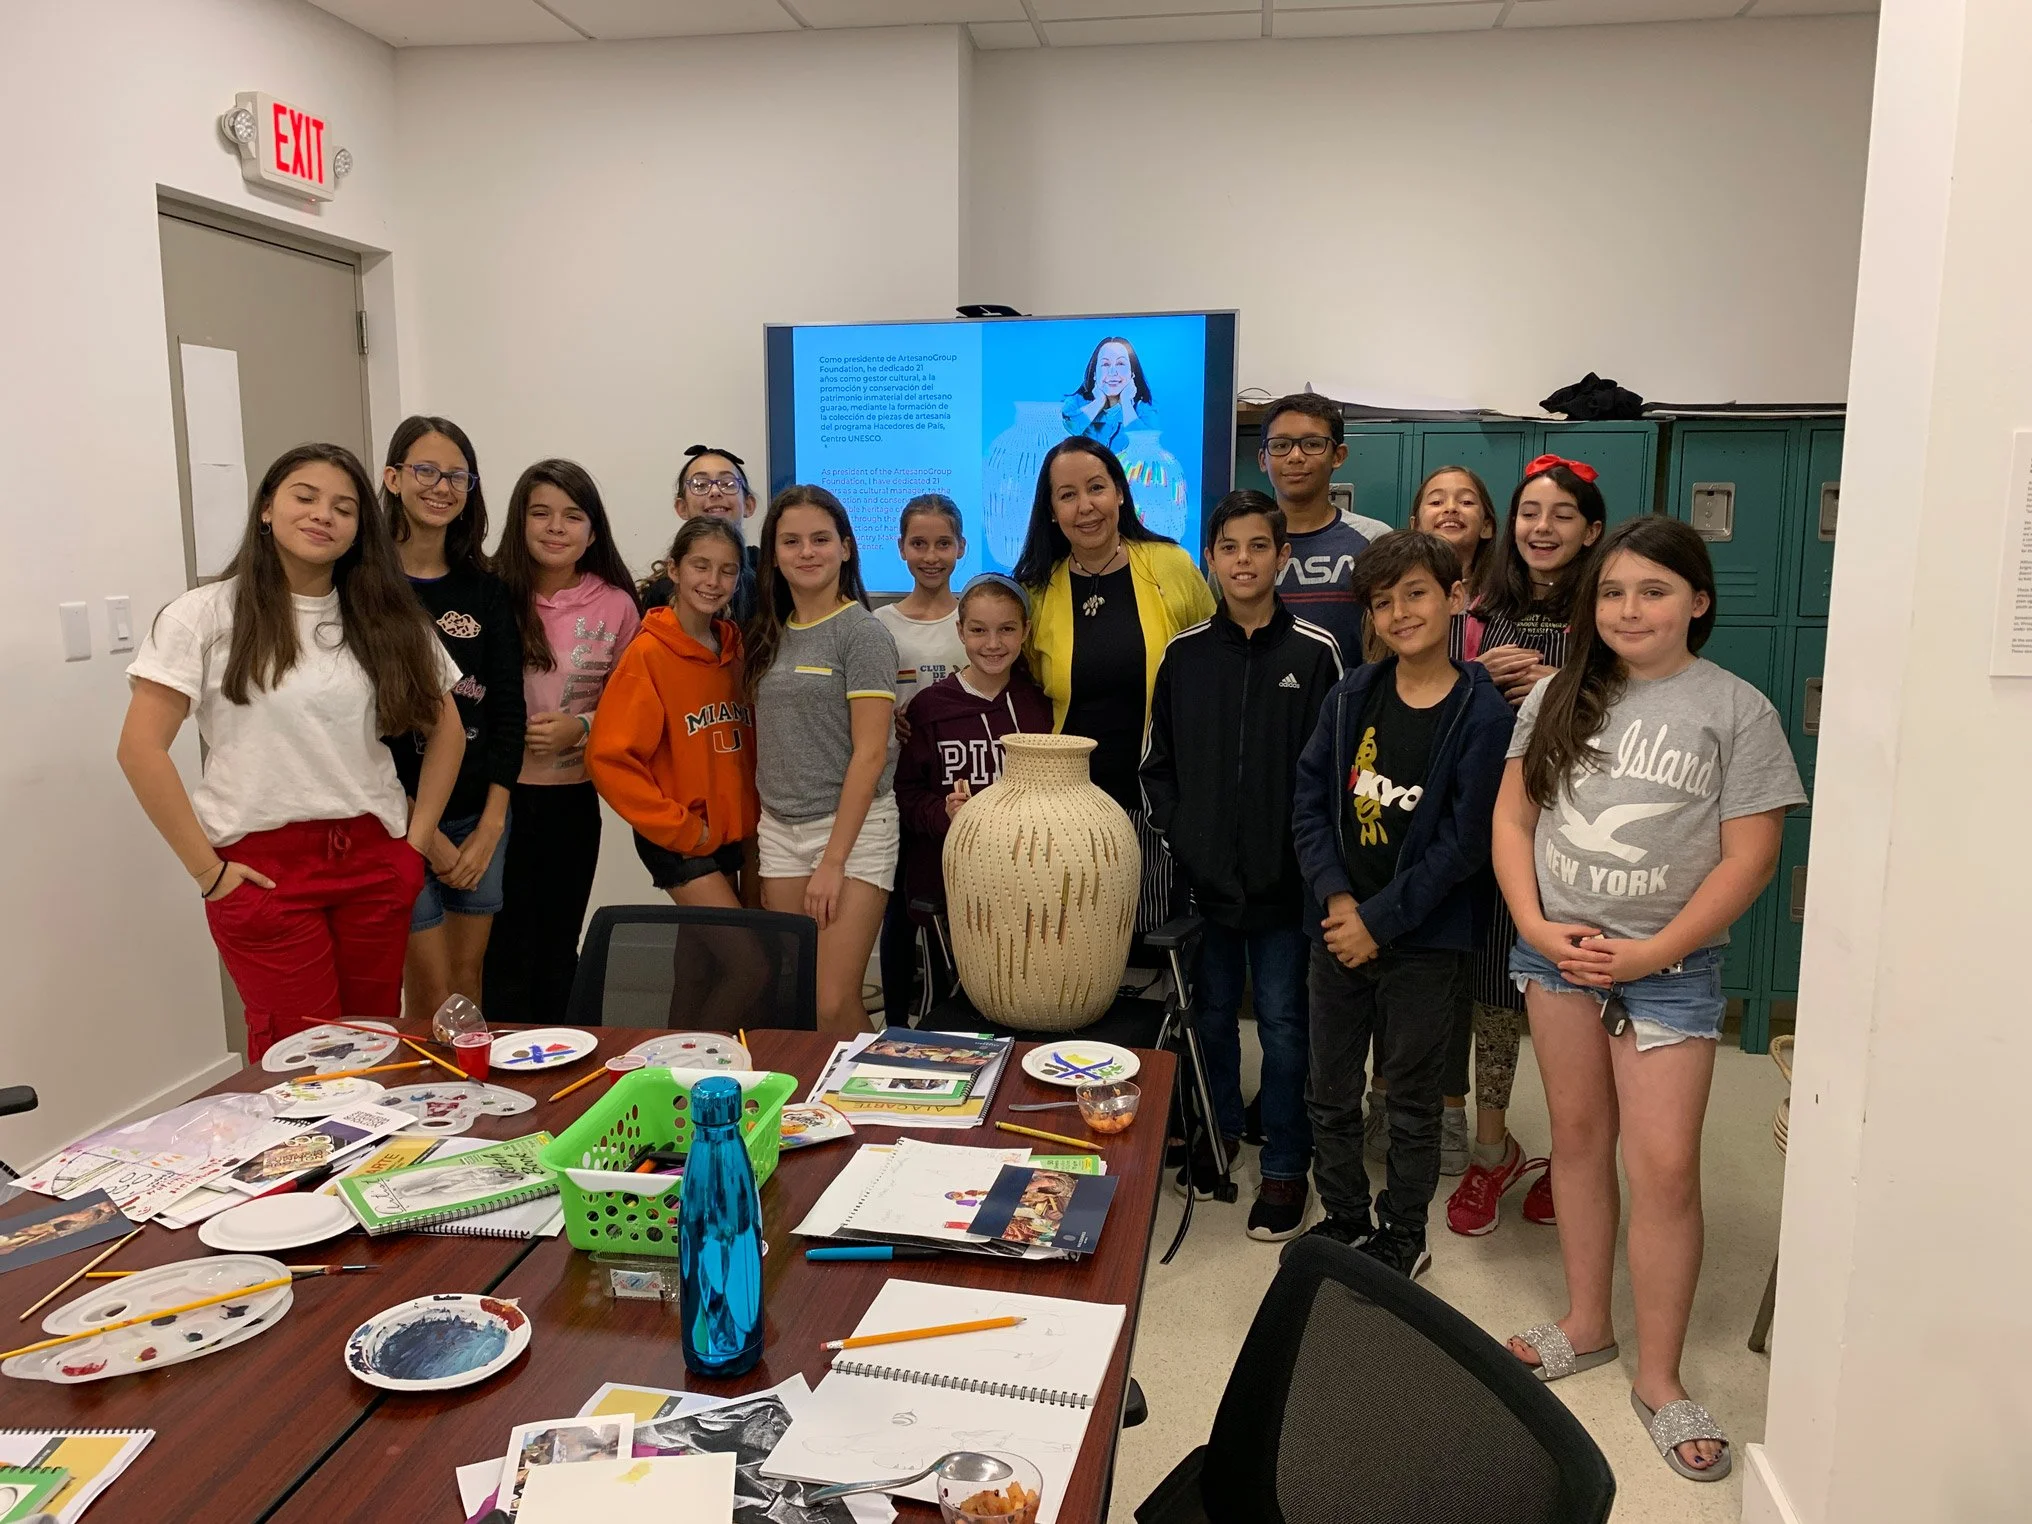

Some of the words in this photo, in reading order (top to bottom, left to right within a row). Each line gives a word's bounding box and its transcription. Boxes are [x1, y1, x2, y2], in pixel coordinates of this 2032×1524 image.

[273, 102, 324, 185] EXIT
[843, 355, 885, 364] presidente
[898, 353, 957, 363] ArtesanoGroup
[820, 365, 865, 373] Foundation,
[878, 364, 914, 372] dedicado
[819, 375, 838, 383] años
[839, 375, 863, 383] como
[863, 375, 887, 383] gestor
[888, 374, 921, 383] cultural,
[928, 373, 936, 381] la
[820, 384, 861, 393] promoción
[921, 383, 934, 391] del
[820, 394, 863, 403] patrimonio
[864, 393, 903, 402] inmaterial
[904, 393, 916, 401] del
[820, 404, 849, 412] guarao,
[850, 403, 886, 411] mediante
[897, 402, 936, 410] formación
[938, 402, 949, 410] de
[820, 413, 827, 421] la
[828, 413, 864, 421] colección
[878, 413, 902, 421] piezas
[834, 424, 872, 432] programa
[873, 422, 914, 430] Hacedores
[847, 434, 882, 442] UNESCO.
[832, 468, 868, 476] president
[894, 467, 952, 476] ArtesanoGroup
[872, 477, 890, 485] have
[892, 477, 931, 485] dedicated
[1275, 554, 1355, 586] ASA
[920, 664, 946, 672] CLUB
[1278, 681, 1300, 689] adidas
[684, 702, 753, 736] MIAM
[712, 729, 742, 753] U
[1611, 719, 1719, 798] Island
[1546, 838, 1580, 886] NEW
[1589, 864, 1670, 896] YORK
[365, 1153, 400, 1174] ARTE
